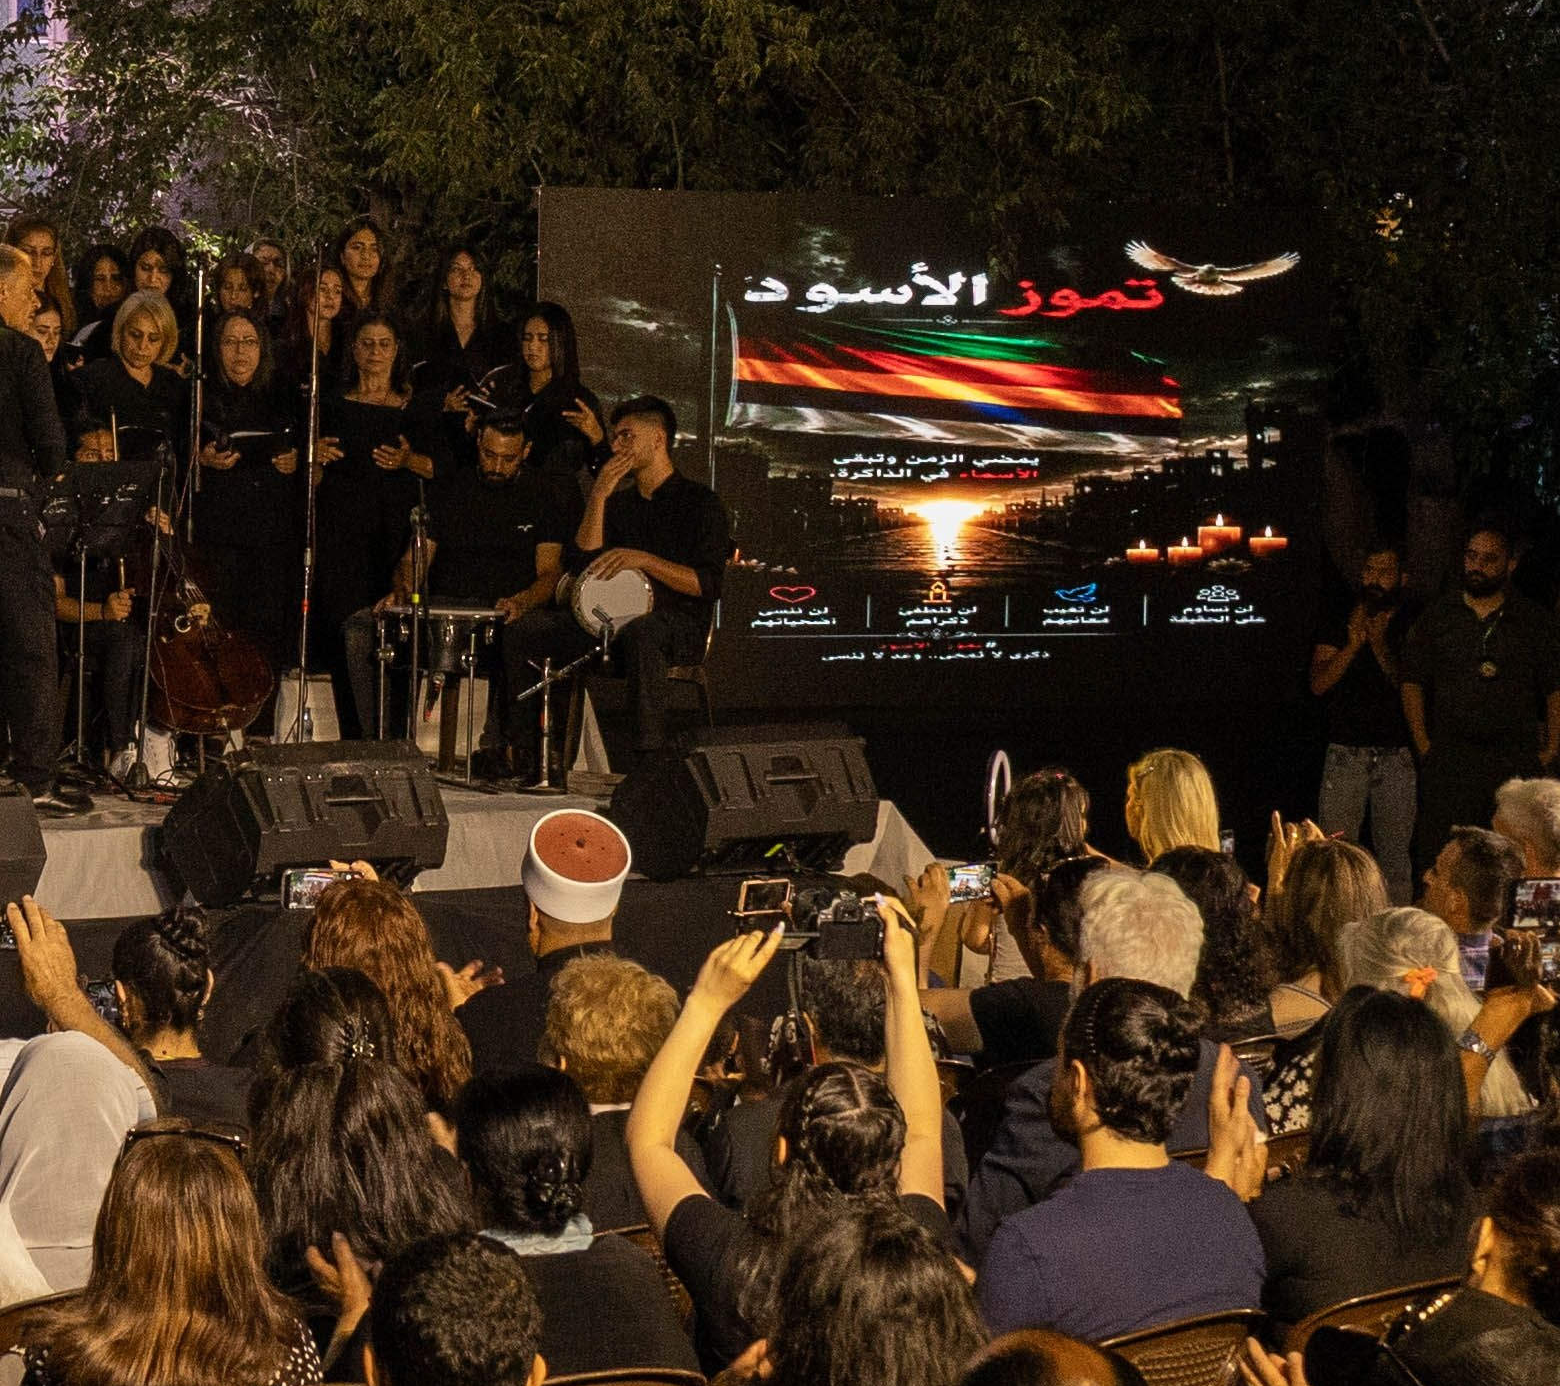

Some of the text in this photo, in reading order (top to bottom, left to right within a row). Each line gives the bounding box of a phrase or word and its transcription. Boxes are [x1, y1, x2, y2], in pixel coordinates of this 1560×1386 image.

[744, 262, 1165, 317] تموز الأسود
[833, 453, 1040, 468] يمضي الزمن وتبقى
[920, 468, 950, 482] في
[959, 468, 1040, 479] الأسماء
[809, 606, 829, 616] لن
[957, 606, 977, 615] لن
[1089, 605, 1110, 614] لن
[1234, 604, 1254, 614] لن
